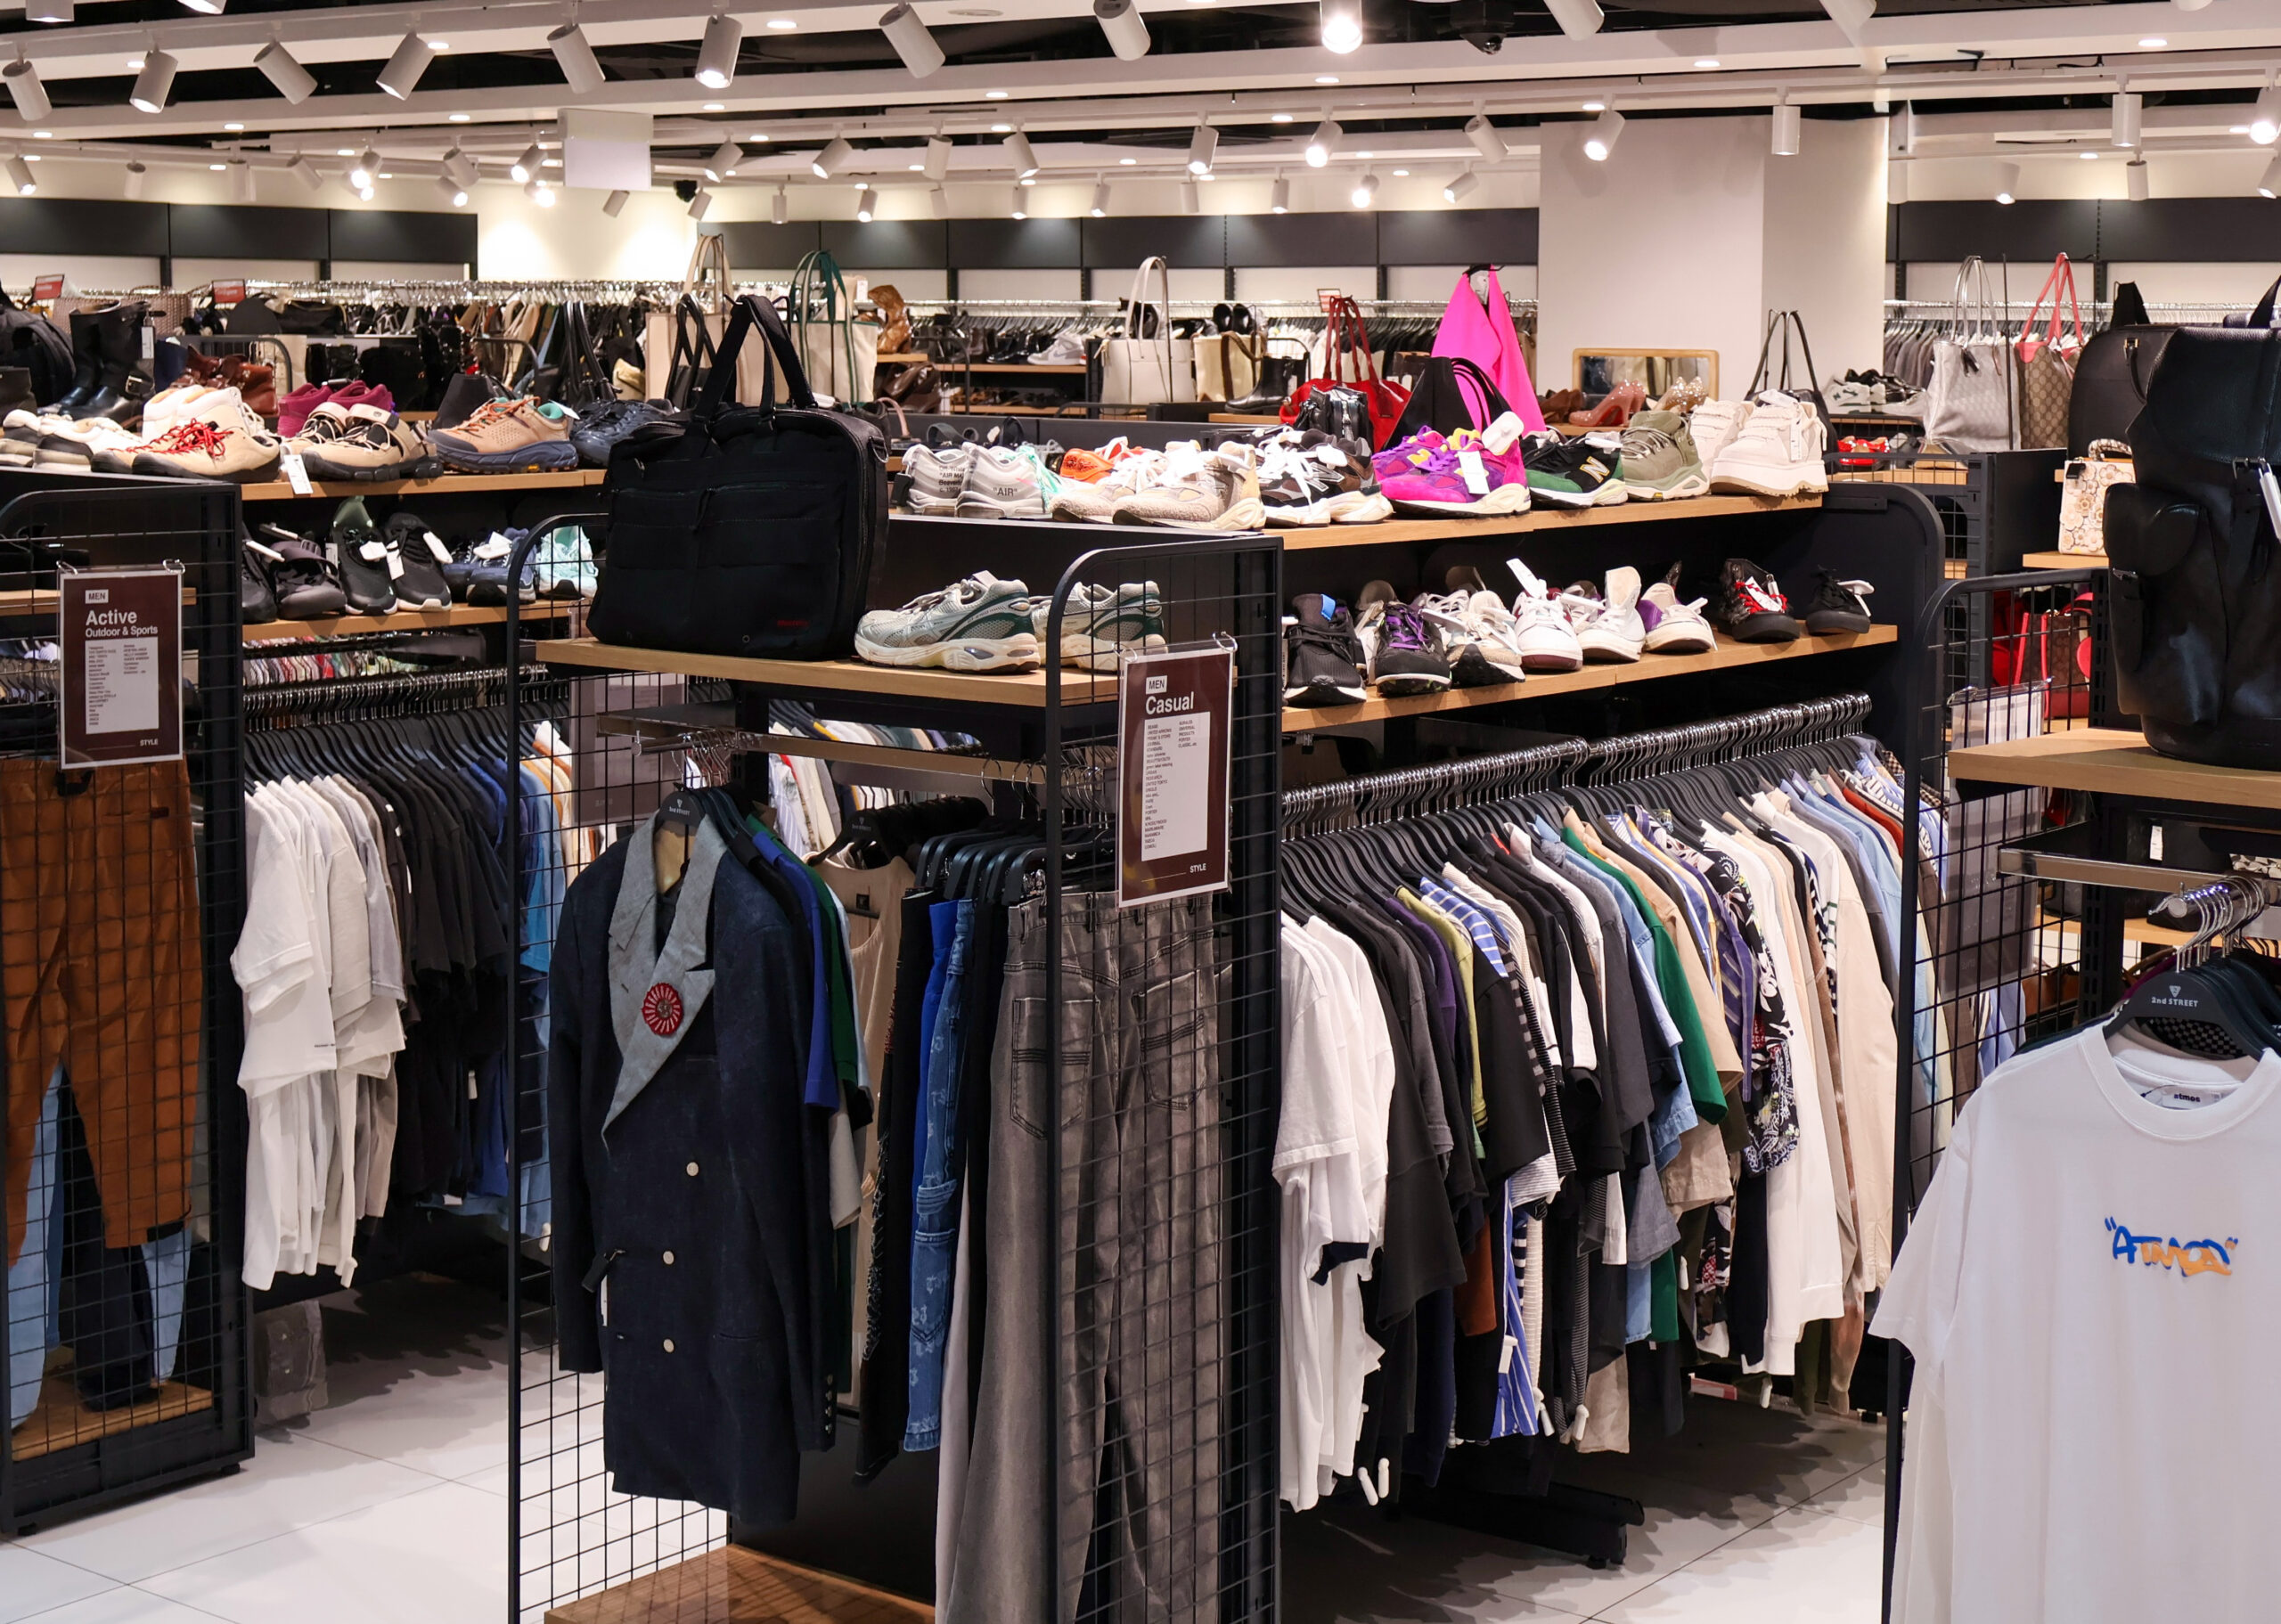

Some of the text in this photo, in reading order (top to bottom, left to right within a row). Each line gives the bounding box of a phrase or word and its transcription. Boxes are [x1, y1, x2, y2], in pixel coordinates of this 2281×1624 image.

[88, 592, 106, 600] MEN
[86, 608, 138, 626] Active
[85, 625, 159, 638] Outdoor & Sports
[1149, 679, 1165, 690] MEN
[1145, 690, 1195, 715] Casual
[140, 738, 159, 747] STYLE
[1190, 862, 1206, 874] STYLE
[2151, 996, 2199, 1008] 2nd STREET
[2173, 1092, 2201, 1103] atmos
